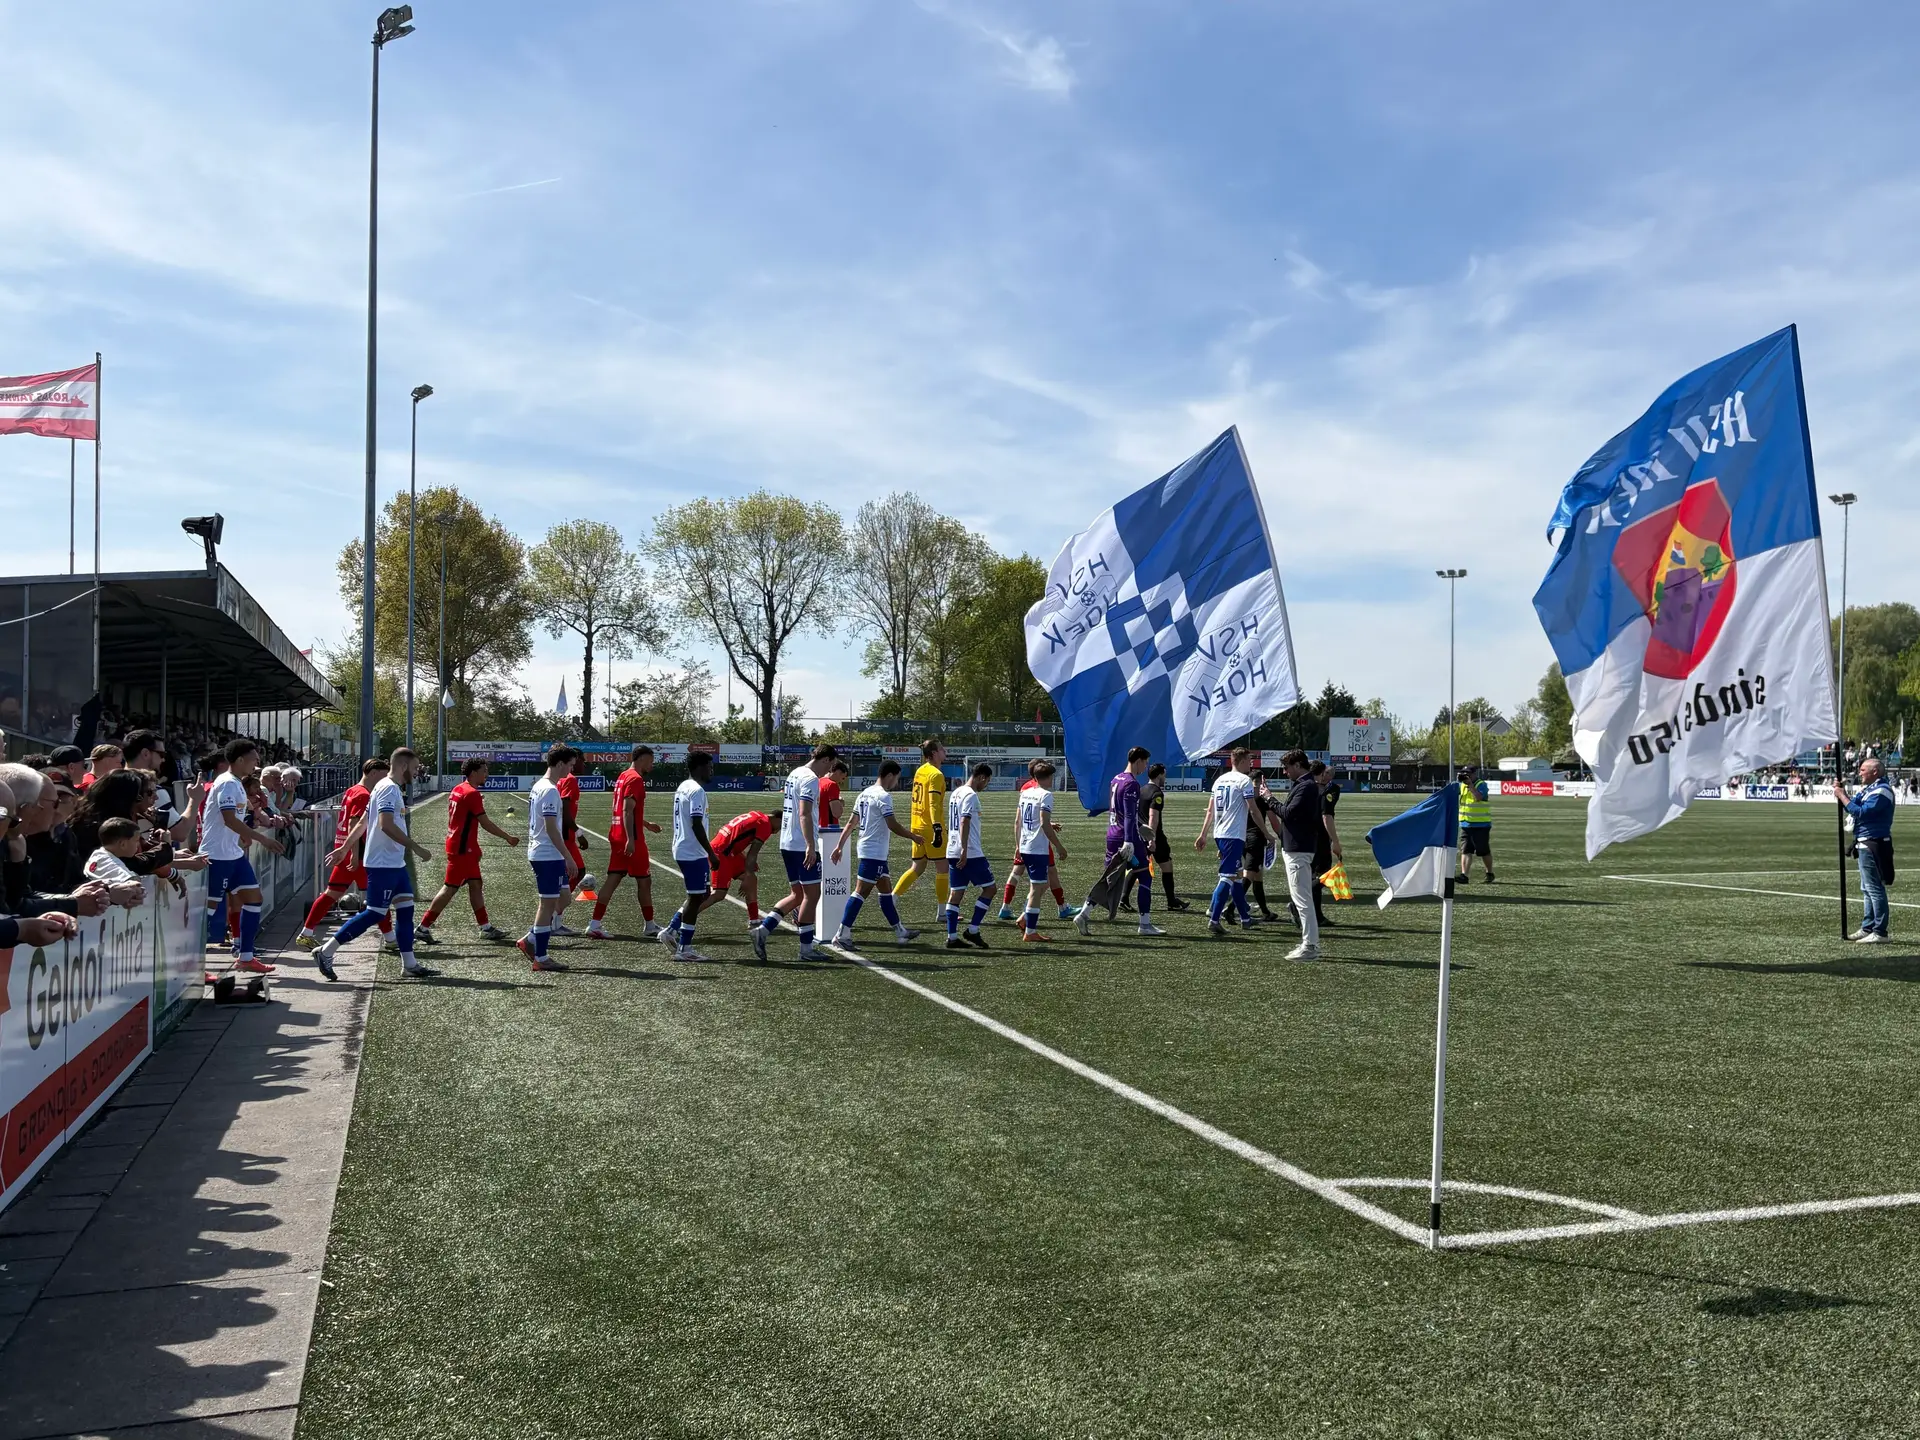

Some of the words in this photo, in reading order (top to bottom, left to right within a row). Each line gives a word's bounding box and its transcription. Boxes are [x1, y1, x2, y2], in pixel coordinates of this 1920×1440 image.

[1348, 728, 1369, 738] HSV
[1348, 743, 1374, 752] HOEK
[593, 754, 613, 762] ING
[1163, 783, 1199, 791] ordeel
[1216, 785, 1231, 811] 21
[1746, 786, 1787, 800] Rbobank
[1021, 802, 1033, 831] 14
[222, 878, 228, 888] 5
[825, 877, 843, 885] HSV
[825, 888, 847, 896] HOEK
[27, 920, 105, 1050] Geldof
[109, 917, 143, 995] Infra
[18, 1078, 77, 1155] GRONDIG
